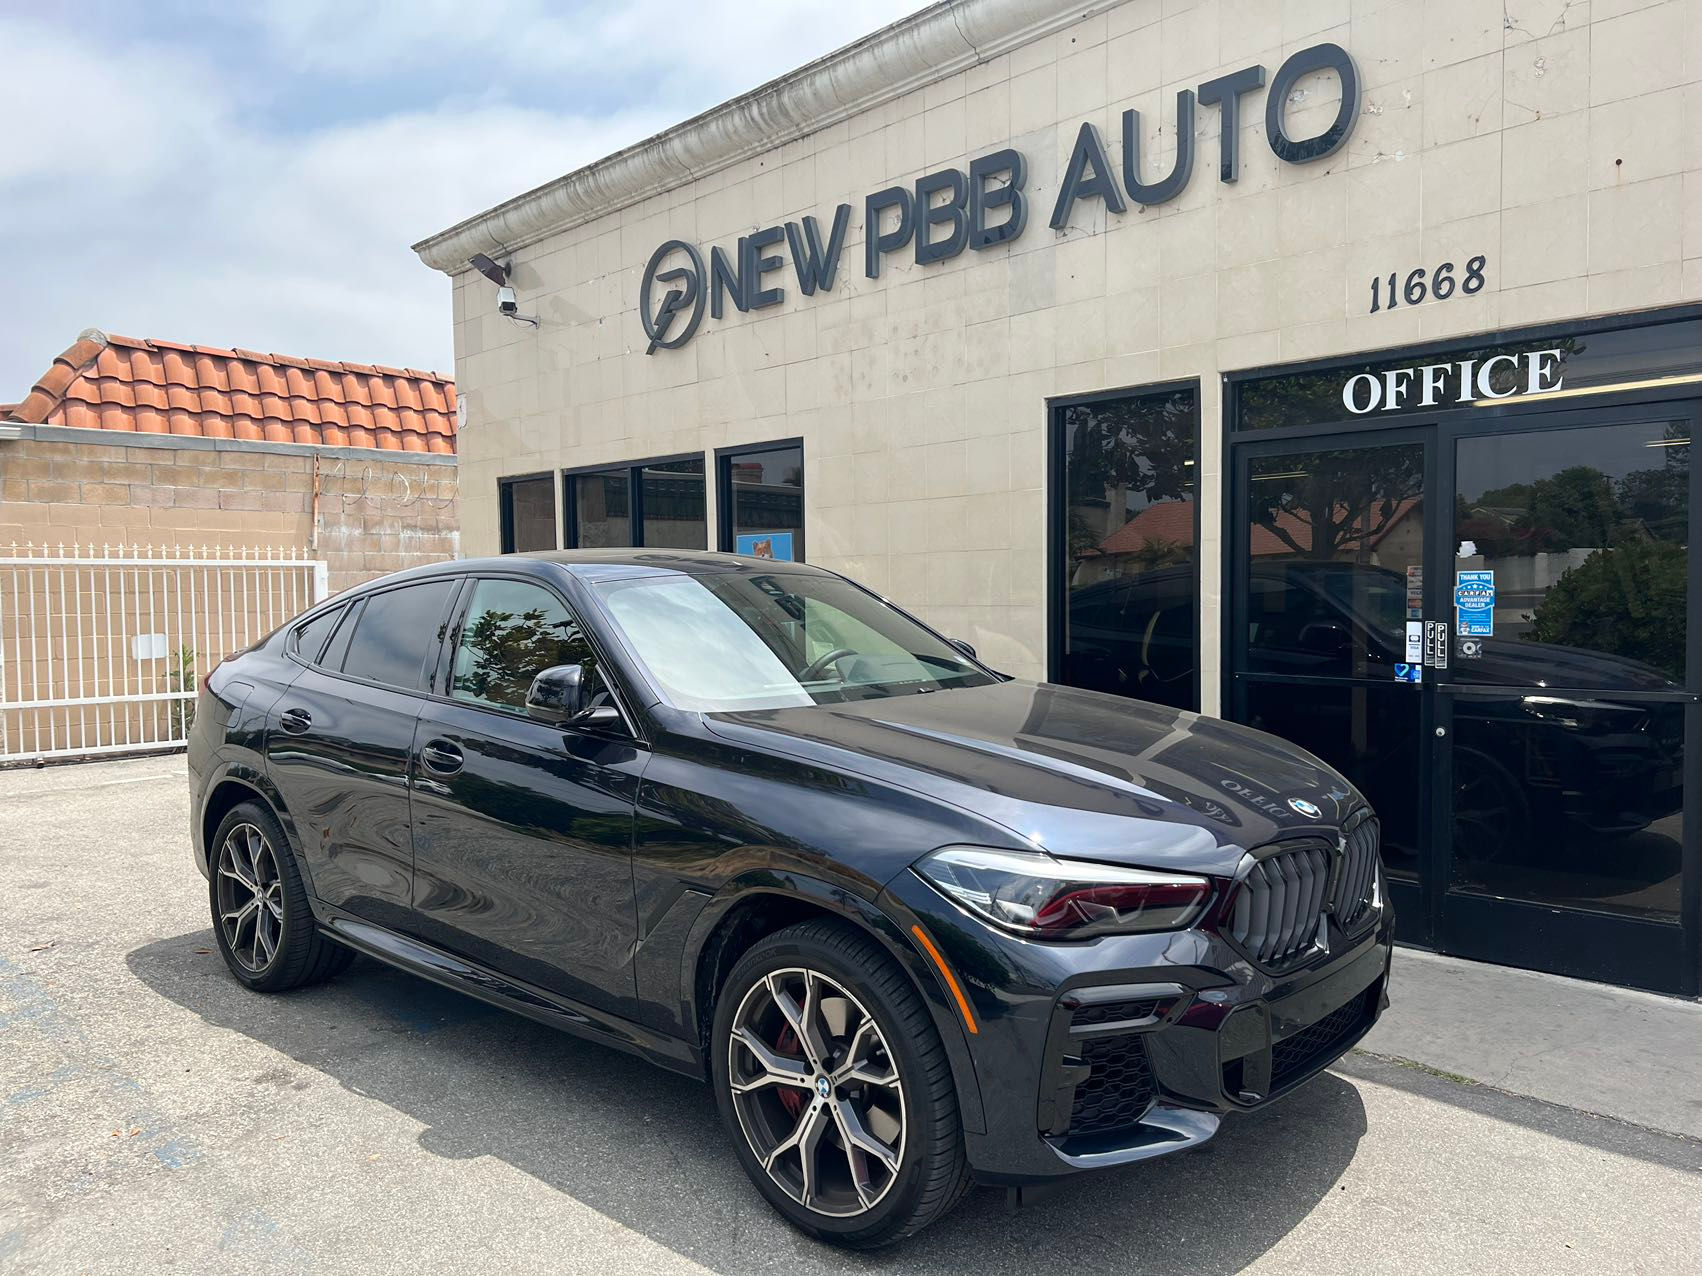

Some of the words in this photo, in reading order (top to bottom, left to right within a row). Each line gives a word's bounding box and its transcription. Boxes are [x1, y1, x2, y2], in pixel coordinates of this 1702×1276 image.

[710, 203, 851, 320] NEW
[865, 148, 1028, 279] PBB
[1049, 42, 1361, 230] AUTO
[1369, 255, 1487, 314] 11668
[1342, 348, 1563, 414] OFFICE
[1437, 624, 1445, 657] PULL
